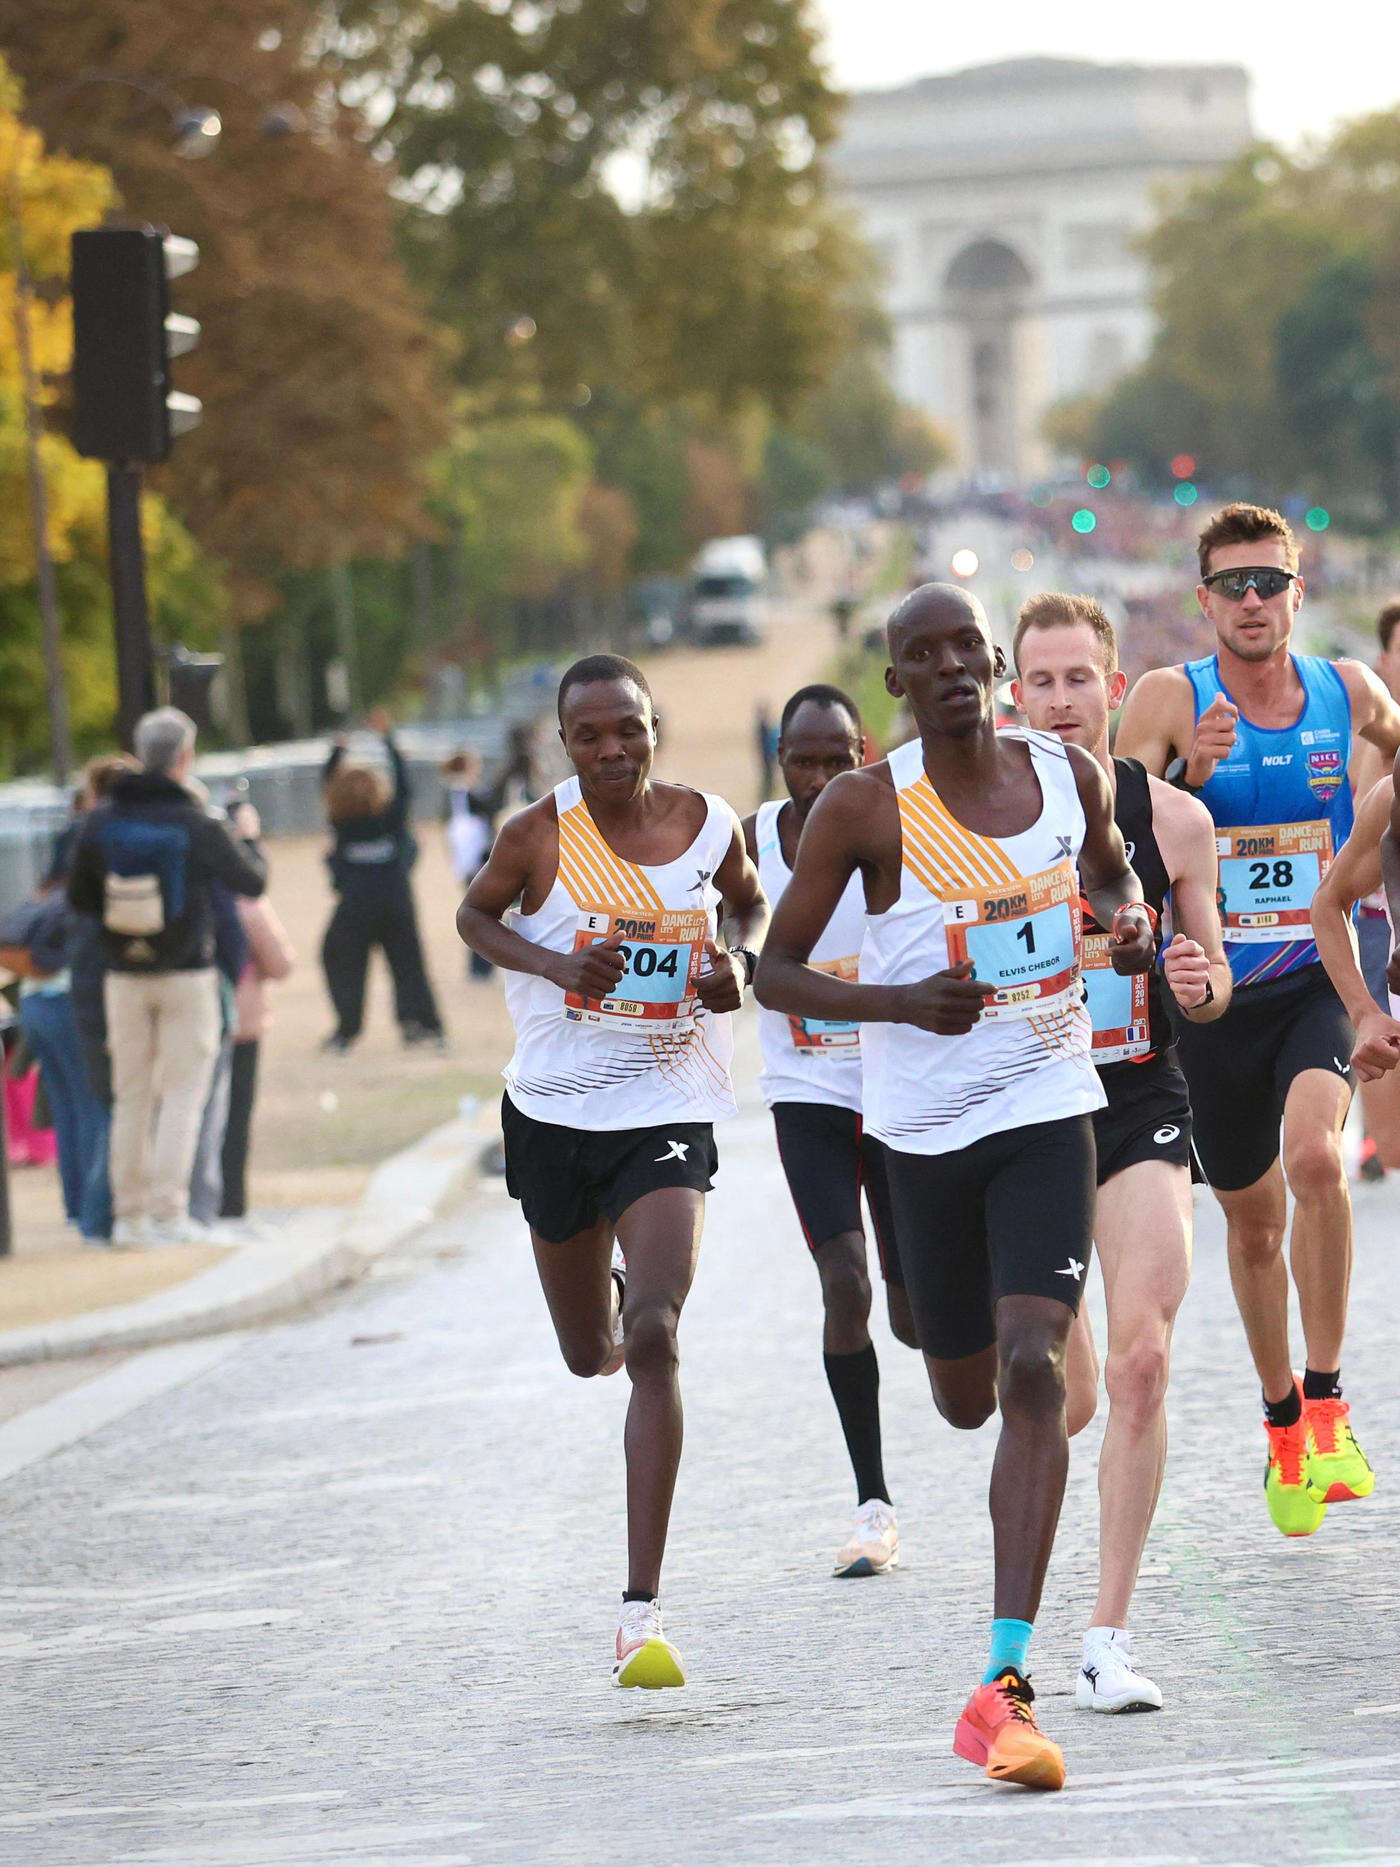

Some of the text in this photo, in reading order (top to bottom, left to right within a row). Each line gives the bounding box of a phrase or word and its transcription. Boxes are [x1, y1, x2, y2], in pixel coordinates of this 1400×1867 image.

[1263, 755, 1293, 766] NOLT
[1310, 752, 1339, 763] NICE
[1279, 827, 1312, 840] DANCE
[1236, 839, 1258, 856] 20
[1259, 837, 1274, 848] KM
[1300, 837, 1323, 851] RUN
[1029, 870, 1060, 891] DANCE
[1249, 861, 1294, 890] 28
[1255, 896, 1292, 904] RAPHAEL
[956, 906, 964, 919] E
[984, 899, 1010, 921] 20
[1010, 894, 1027, 908] KM
[588, 917, 596, 928] E
[662, 914, 692, 926] DANCE
[613, 918, 656, 938] 20 KM
[679, 927, 698, 942] RUN
[1016, 921, 1036, 954] 1
[1085, 937, 1109, 951] DAN
[1000, 956, 1060, 977] ELVIS CHEBOR
